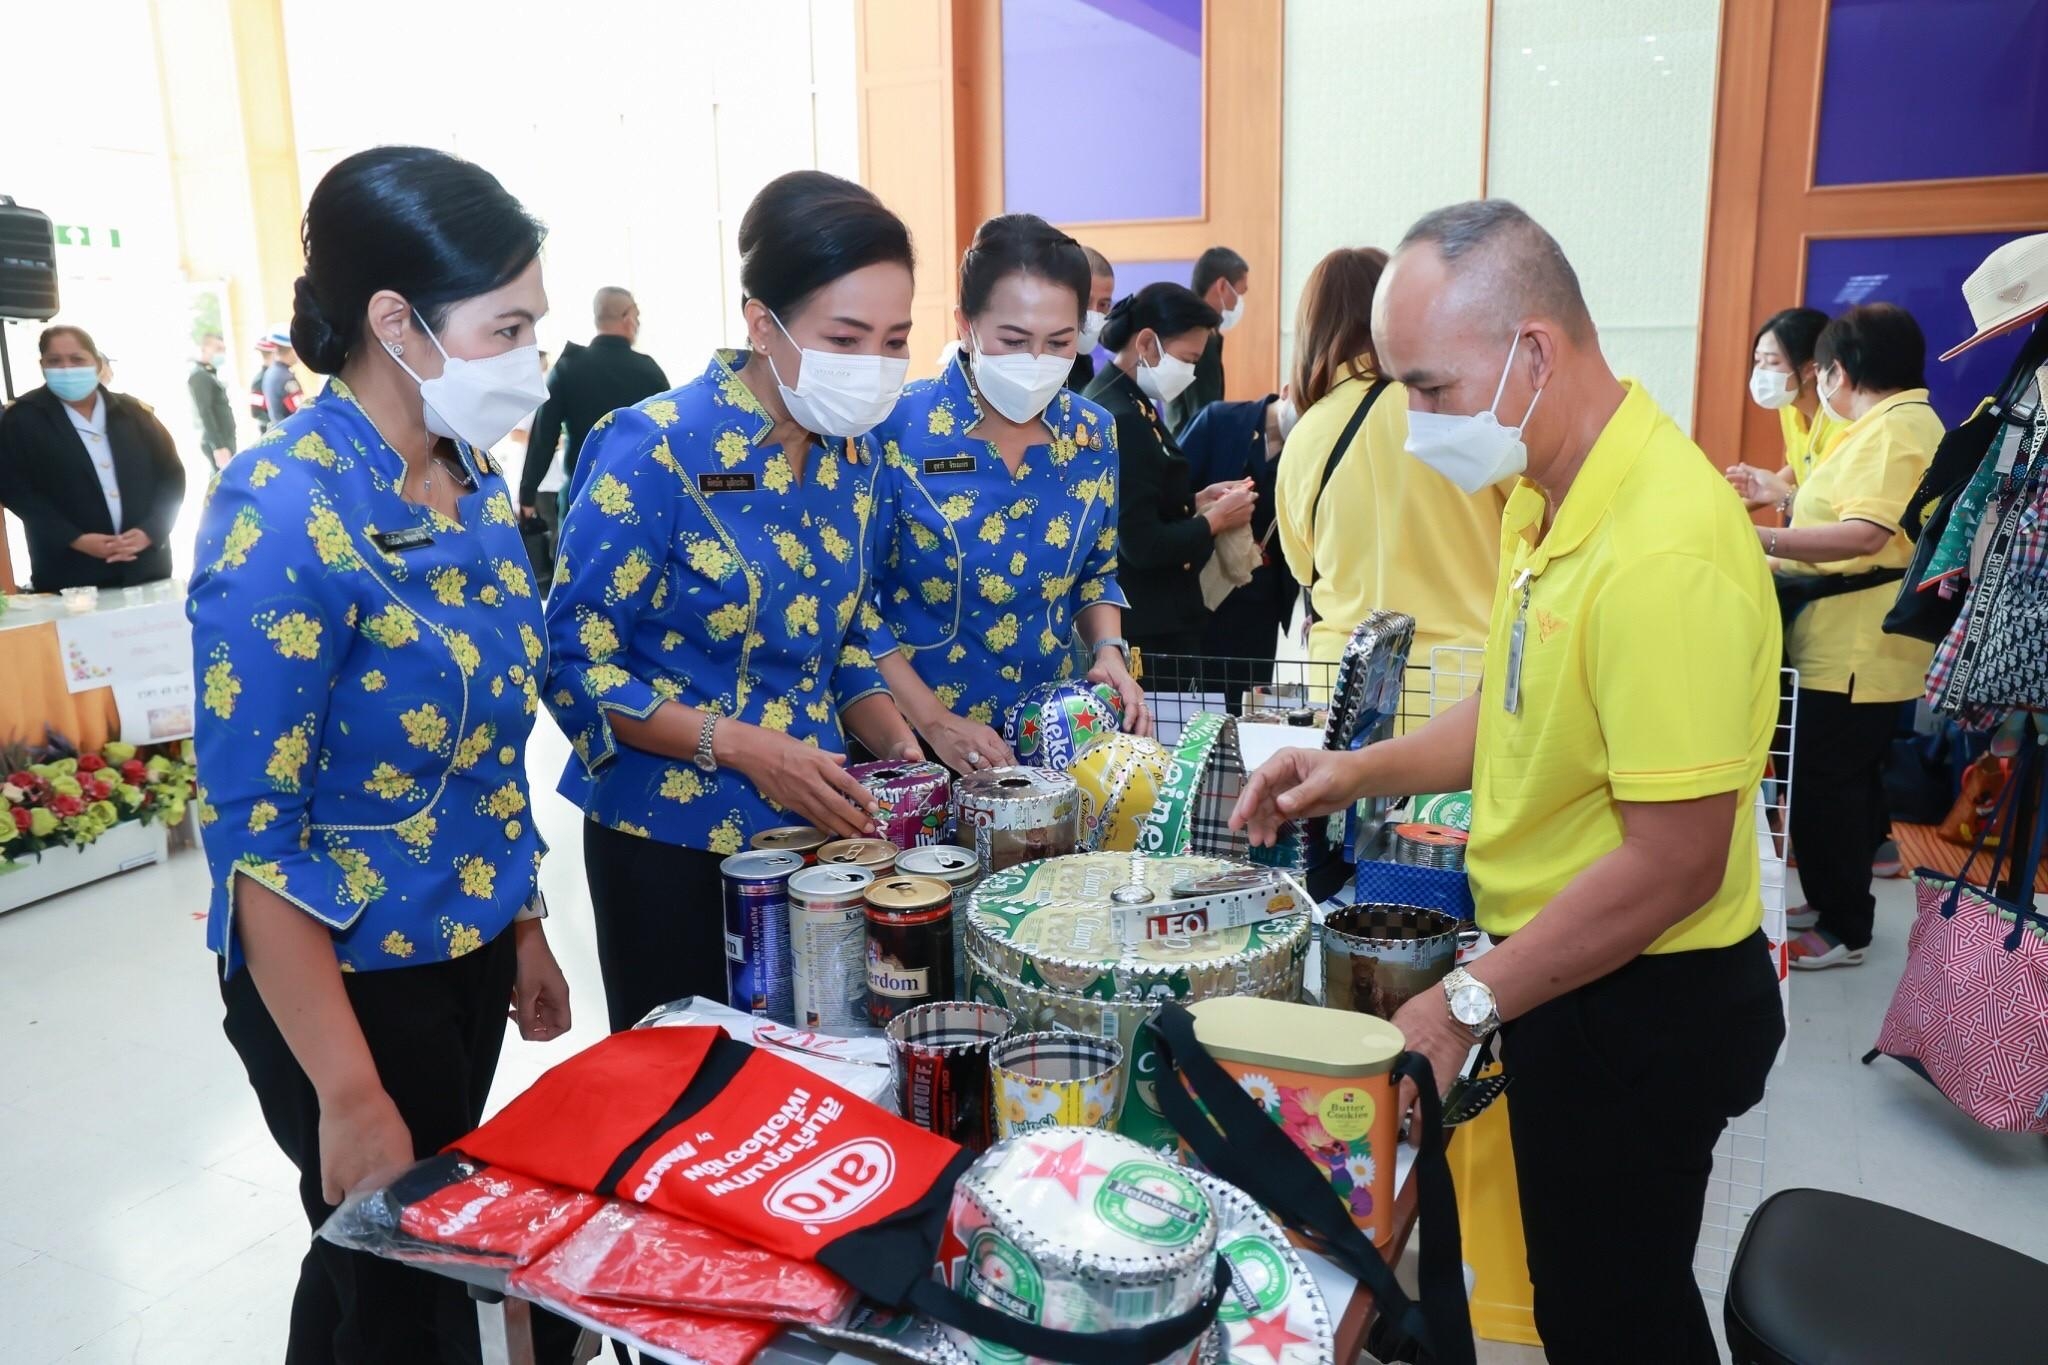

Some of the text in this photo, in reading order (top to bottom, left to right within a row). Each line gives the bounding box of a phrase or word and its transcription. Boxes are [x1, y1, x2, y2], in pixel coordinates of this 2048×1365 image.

[2001, 509, 2018, 537] DIOR
[1966, 552, 2003, 641] CHRISTIAN DIOR
[1038, 768, 1066, 783] LEO
[1079, 866, 1110, 897] Chang
[1068, 916, 1103, 954] Chang
[1149, 913, 1205, 939] LEO
[914, 1063, 933, 1130] IRNOFF.
[1327, 1111, 1368, 1119] Cookies
[1331, 1103, 1366, 1112] Butter
[682, 1087, 812, 1182] เพื่อมืออาชีพ
[705, 1096, 845, 1197] สินค้าคุณภาพ
[634, 1131, 714, 1203] by makro
[782, 1152, 878, 1215] aro
[1115, 1183, 1192, 1220] Heineken
